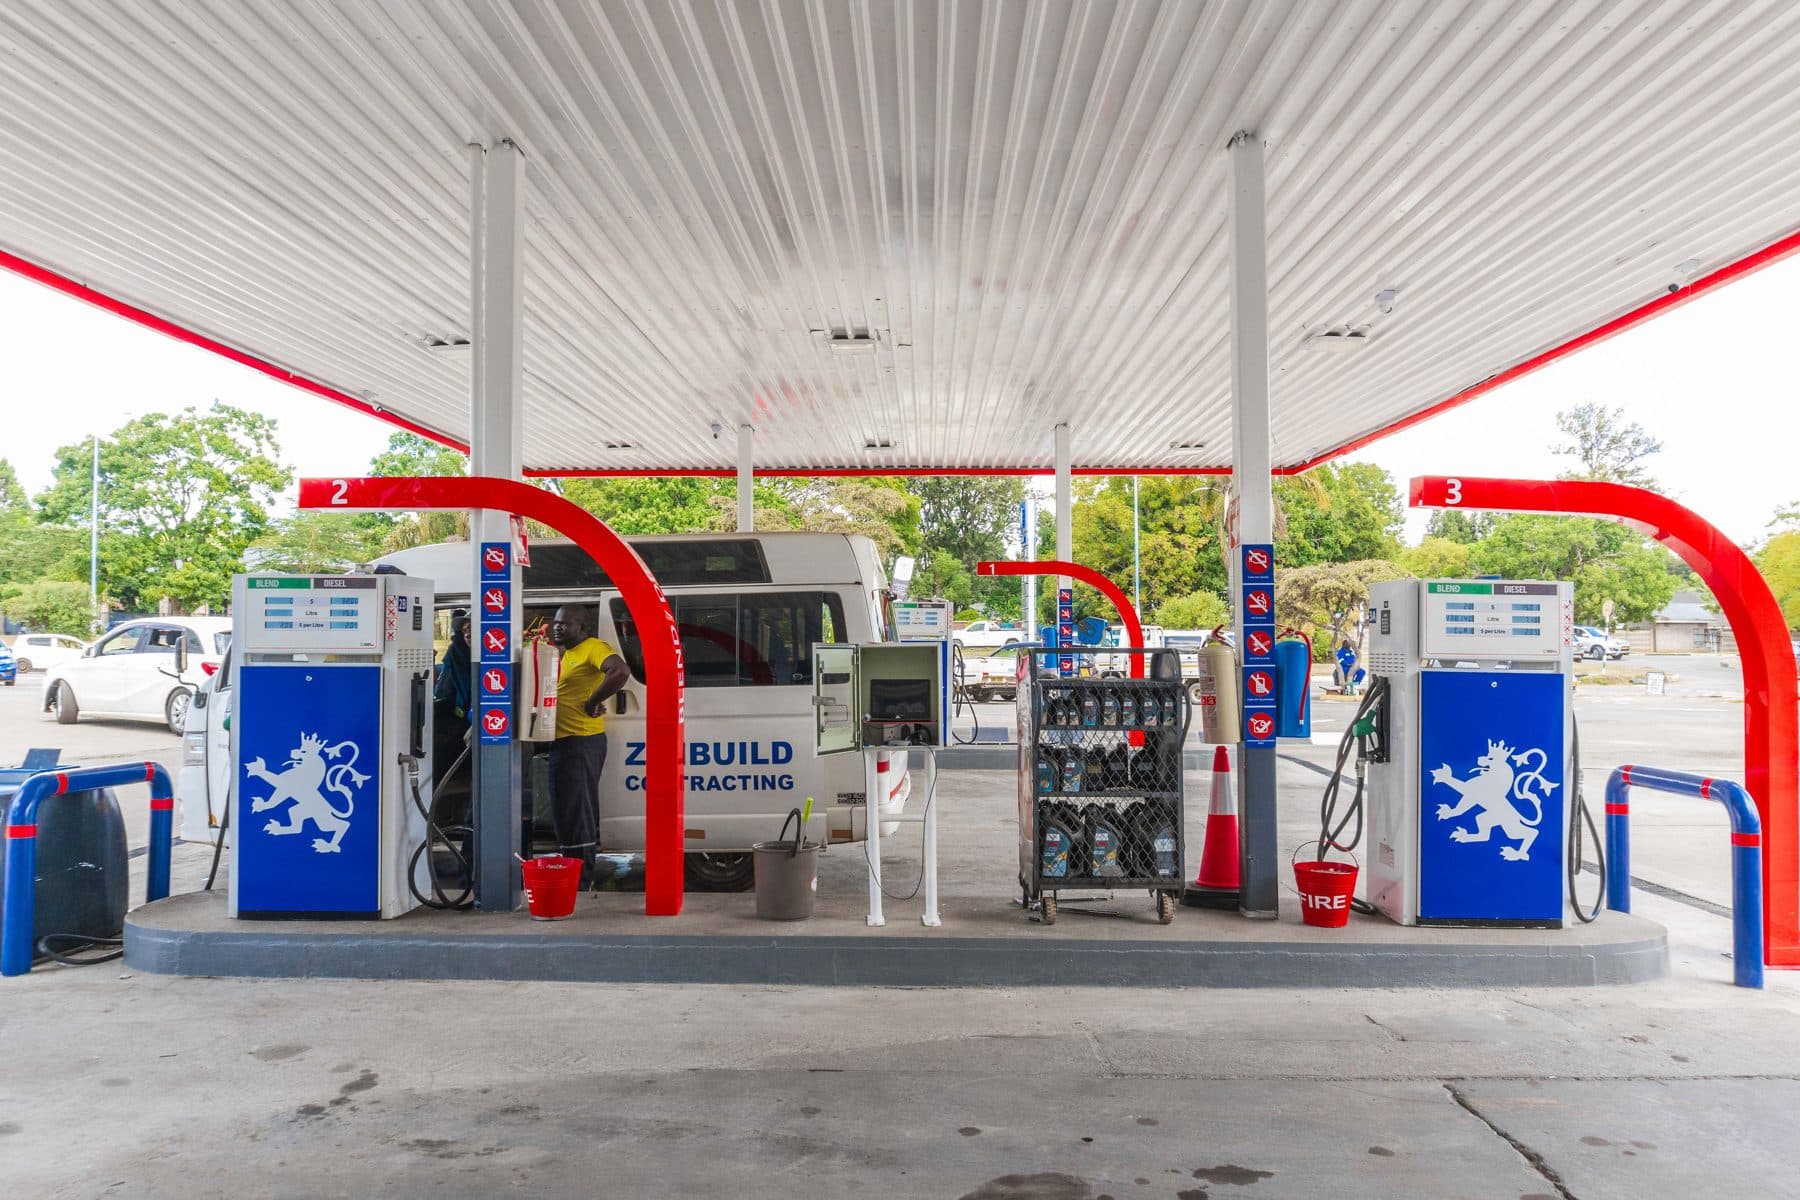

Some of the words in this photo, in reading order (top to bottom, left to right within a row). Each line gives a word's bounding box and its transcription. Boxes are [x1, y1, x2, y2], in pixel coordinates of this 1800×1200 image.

[331, 479, 348, 504] 2
[1444, 478, 1463, 505] 3
[988, 563, 996, 575] 1
[255, 579, 280, 588] BLEND
[323, 579, 347, 588] DIESEL
[1436, 585, 1461, 593] BLEND
[1503, 585, 1528, 594] DIESEL
[398, 598, 407, 609] 2B
[625, 740, 793, 766] ZBUILD
[625, 774, 794, 791] CRACTING
[1298, 891, 1347, 910] FIRE
